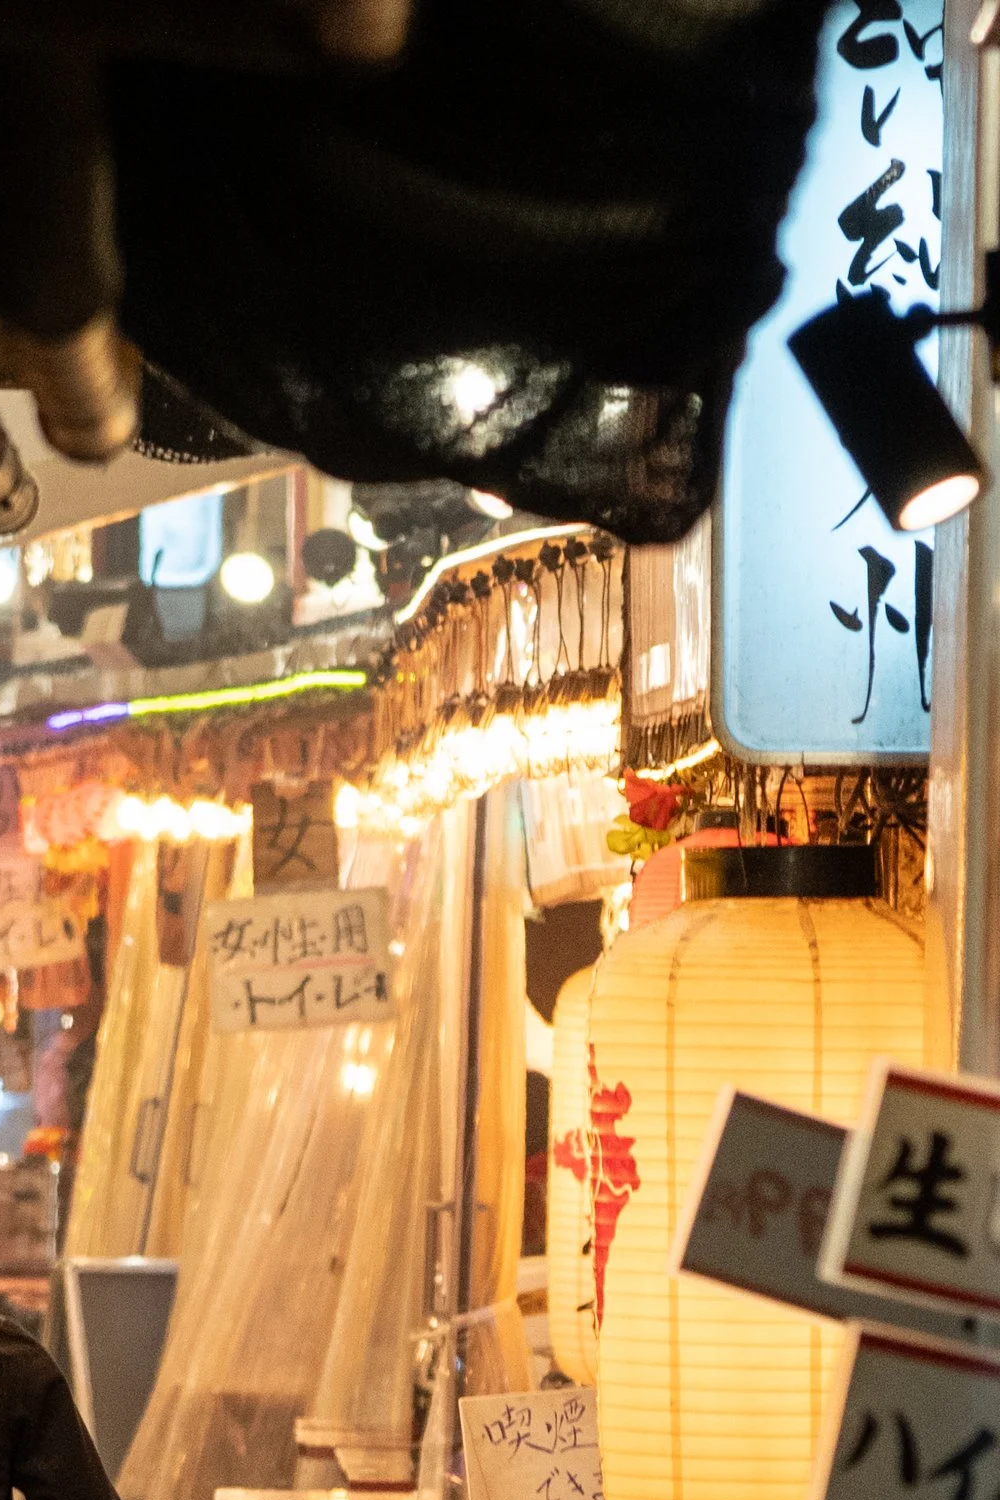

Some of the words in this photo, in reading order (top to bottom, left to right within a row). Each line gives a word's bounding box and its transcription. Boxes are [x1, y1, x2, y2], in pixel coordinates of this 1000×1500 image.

[258, 796, 336, 877] 女
[213, 904, 369, 966] 女性用
[243, 974, 362, 1025] トイレ
[869, 1130, 970, 1258] 生
[482, 1398, 599, 1460] 喫煙
